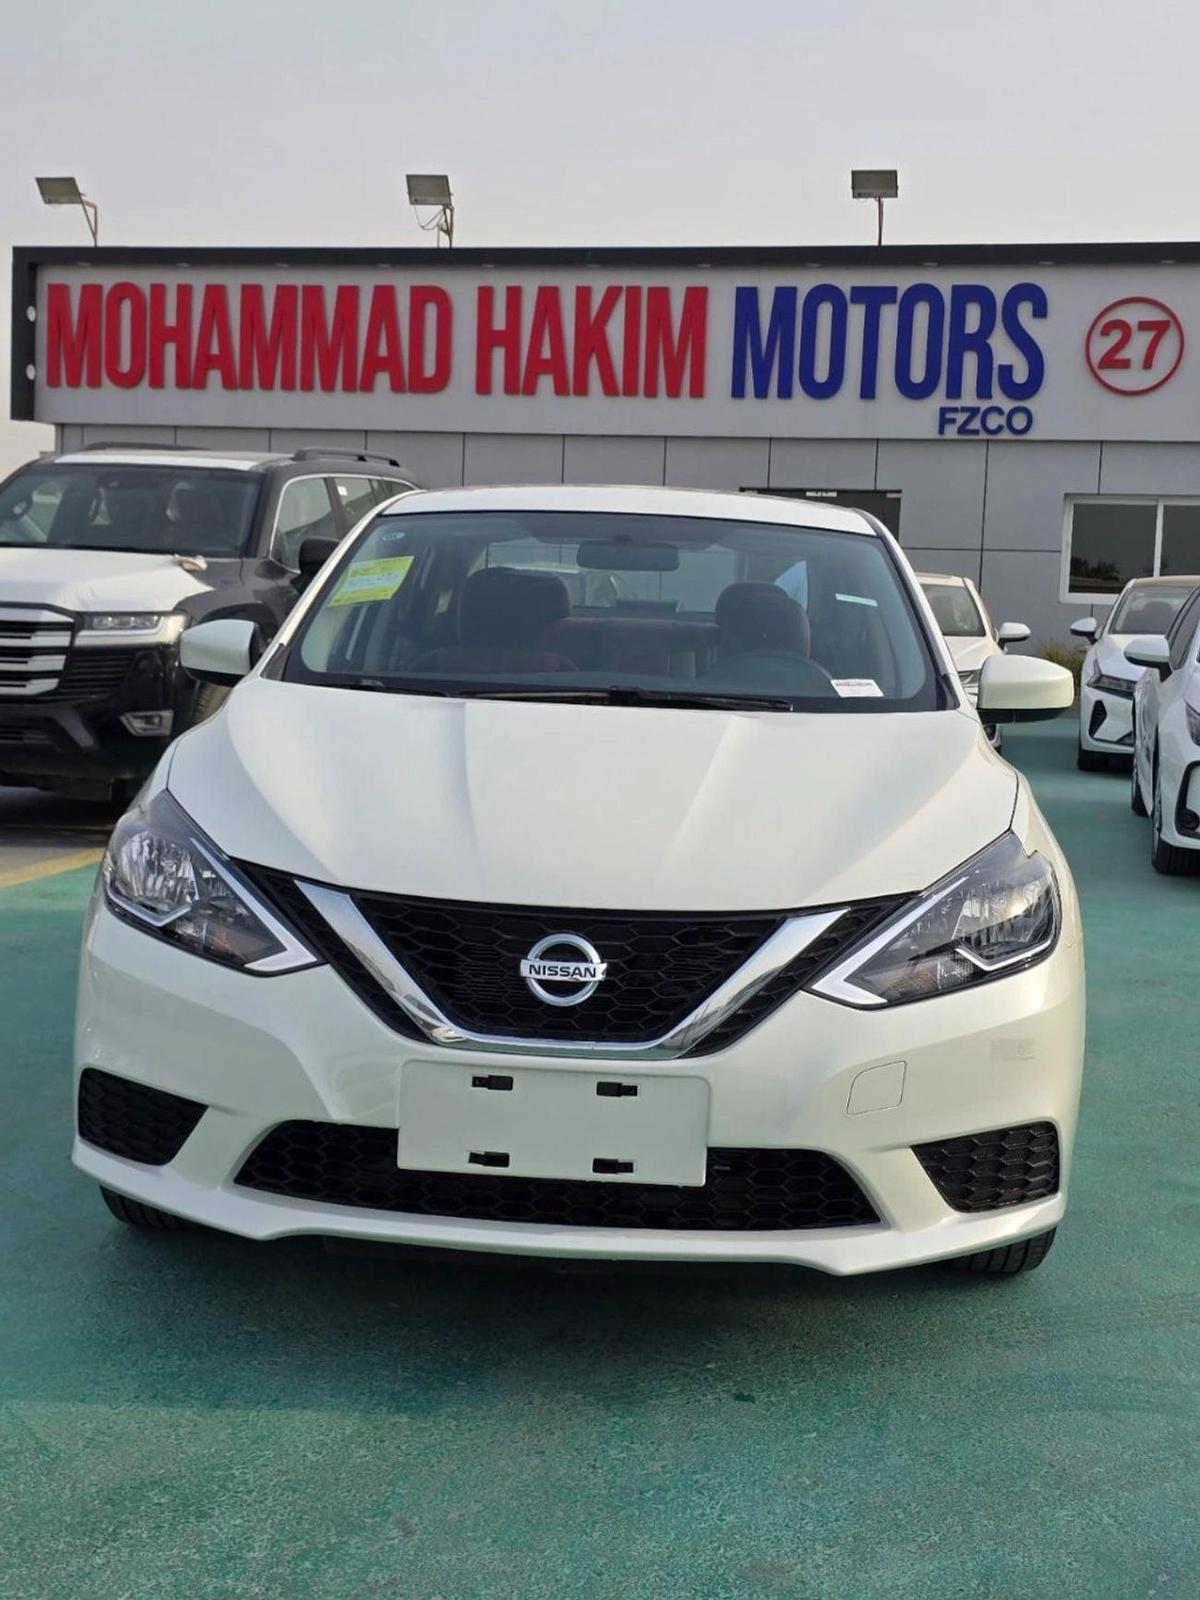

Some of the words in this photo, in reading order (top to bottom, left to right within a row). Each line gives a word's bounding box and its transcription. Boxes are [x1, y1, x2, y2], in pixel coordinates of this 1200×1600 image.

[46, 281, 452, 393] MOHAMMAD
[475, 285, 708, 397] HAKIM
[731, 282, 1048, 400] MOTORS
[1097, 319, 1171, 370] 27
[938, 405, 1034, 437] FZCO
[529, 964, 597, 978] NISSAN
